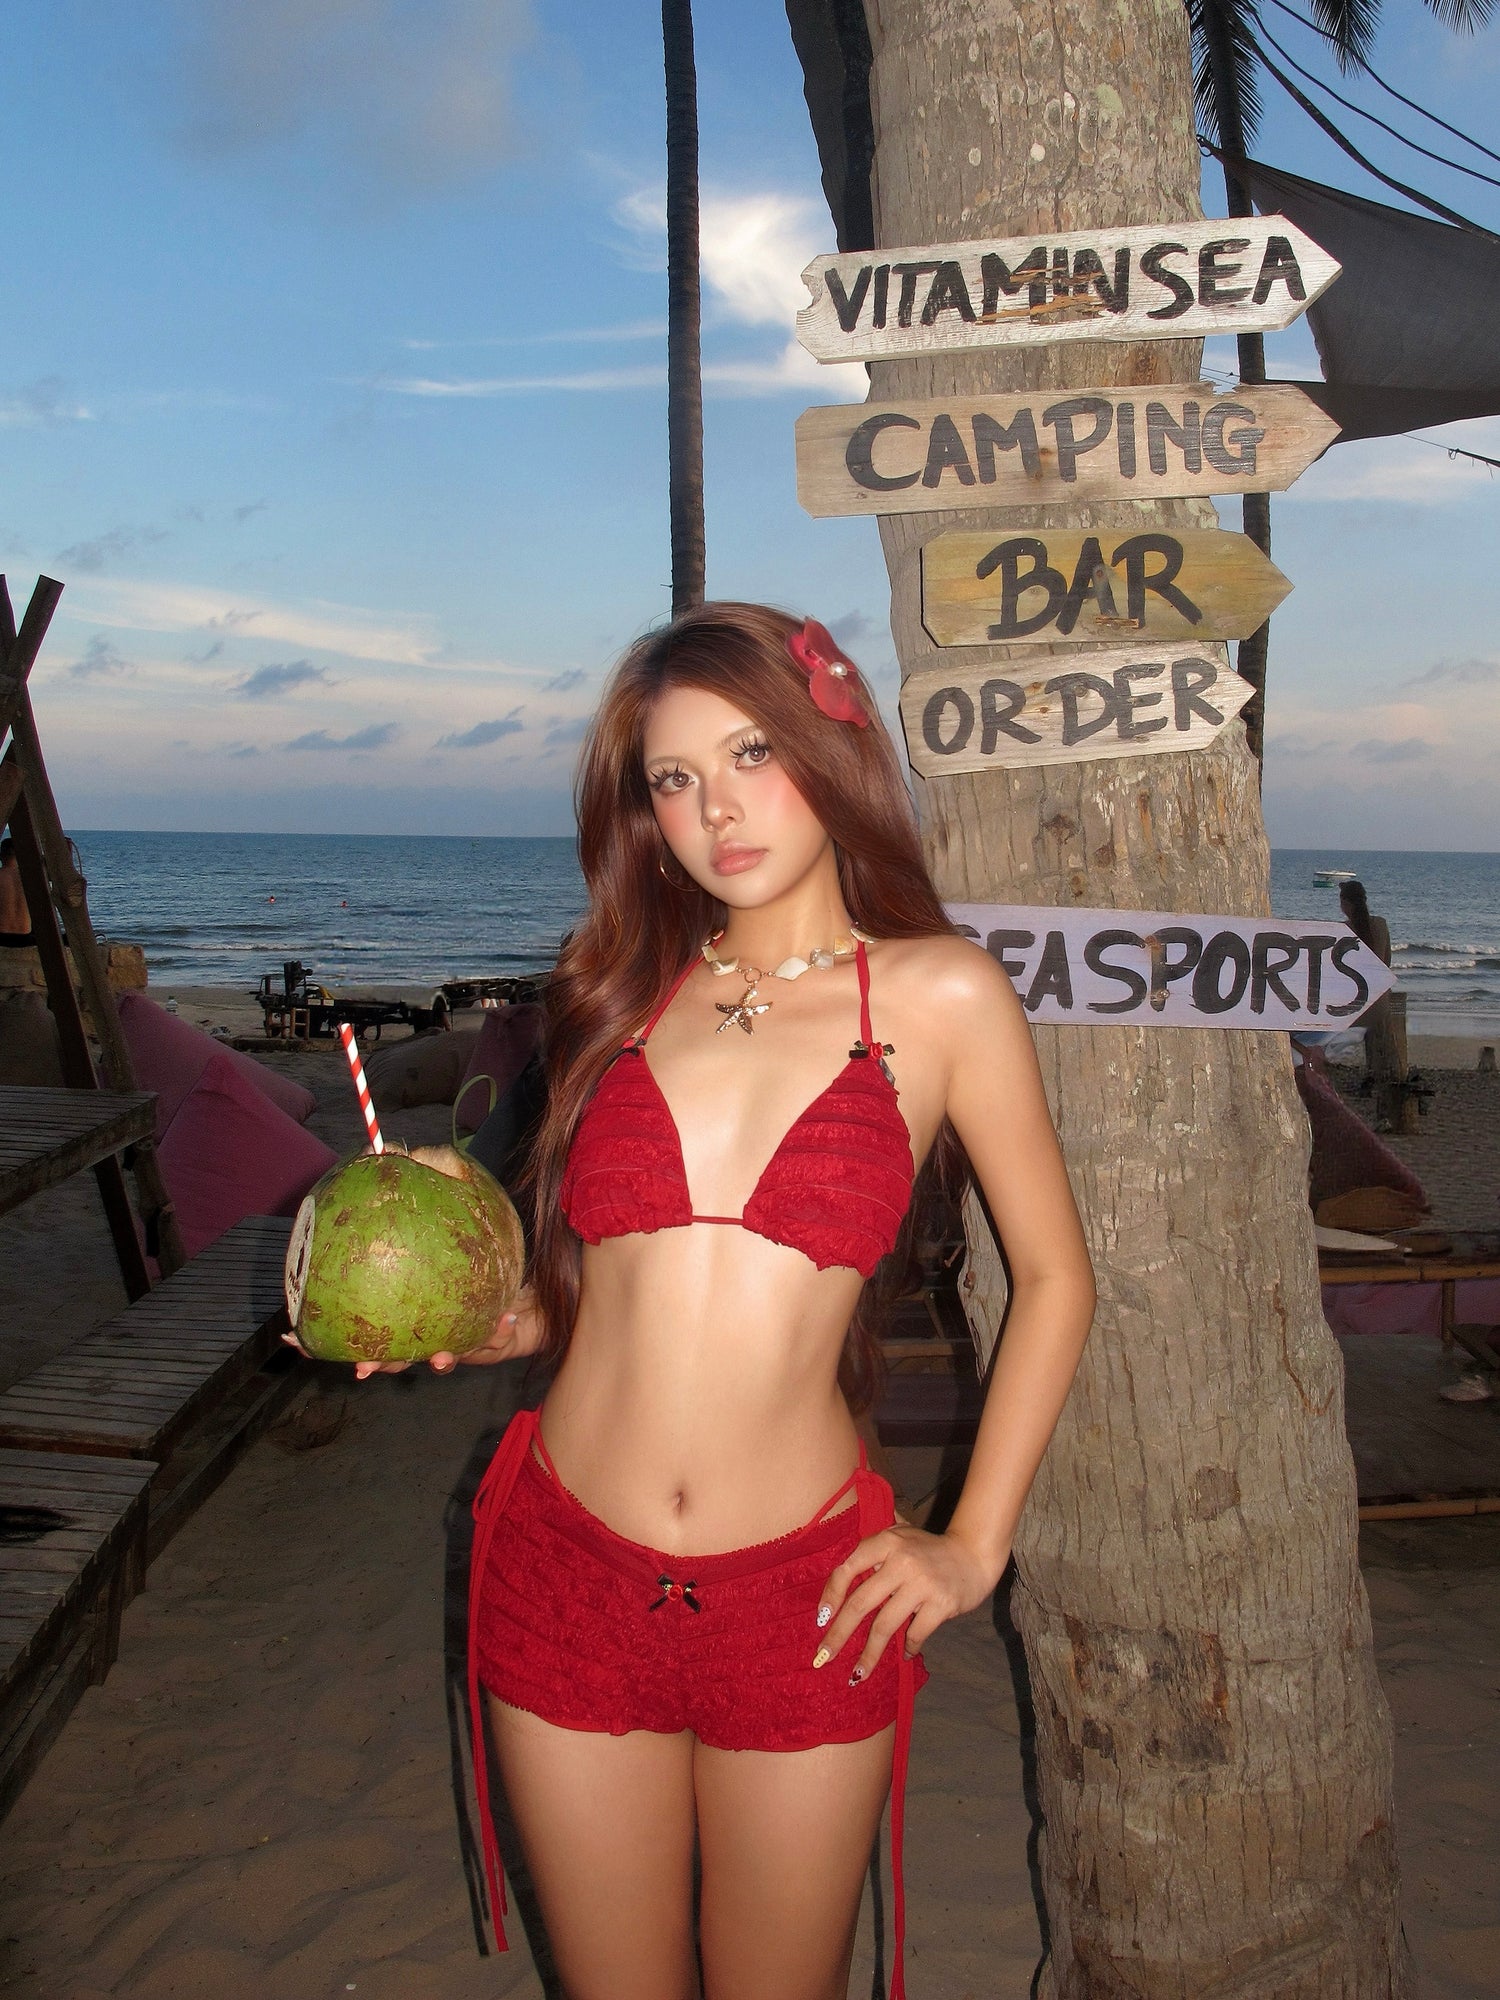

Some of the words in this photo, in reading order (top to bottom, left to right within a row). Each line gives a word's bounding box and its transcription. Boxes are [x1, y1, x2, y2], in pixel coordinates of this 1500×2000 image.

[845, 397, 1265, 491] CAMPING
[976, 534, 1202, 640] BAR
[922, 658, 1225, 755] ORDER
[954, 924, 1074, 1012] EA
